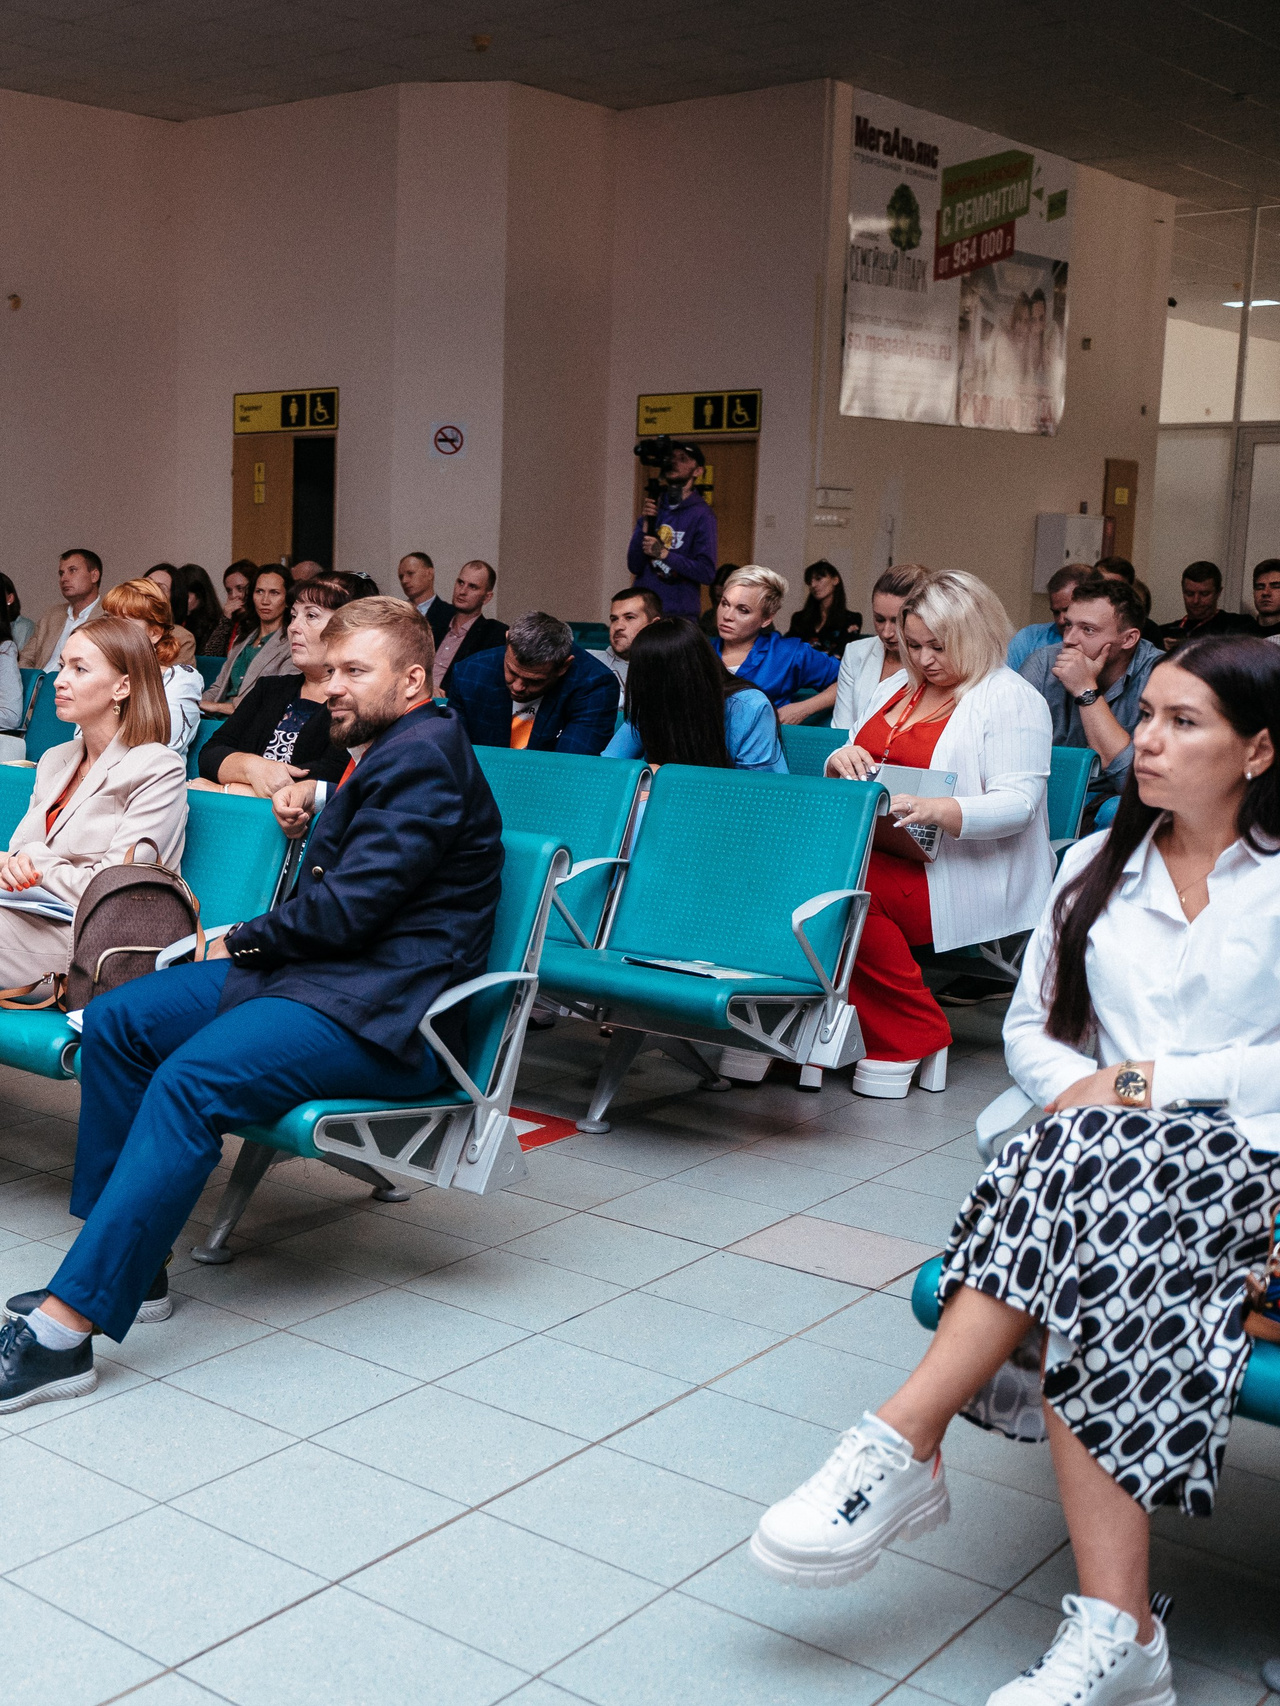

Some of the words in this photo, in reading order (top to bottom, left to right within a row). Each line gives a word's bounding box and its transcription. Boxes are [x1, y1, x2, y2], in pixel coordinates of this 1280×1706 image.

[855, 115, 939, 169] МегаАльянс
[942, 206, 951, 237] С
[955, 180, 1028, 232] РЕМОНТОМ
[953, 237, 977, 269] 954
[980, 229, 1004, 260] 000
